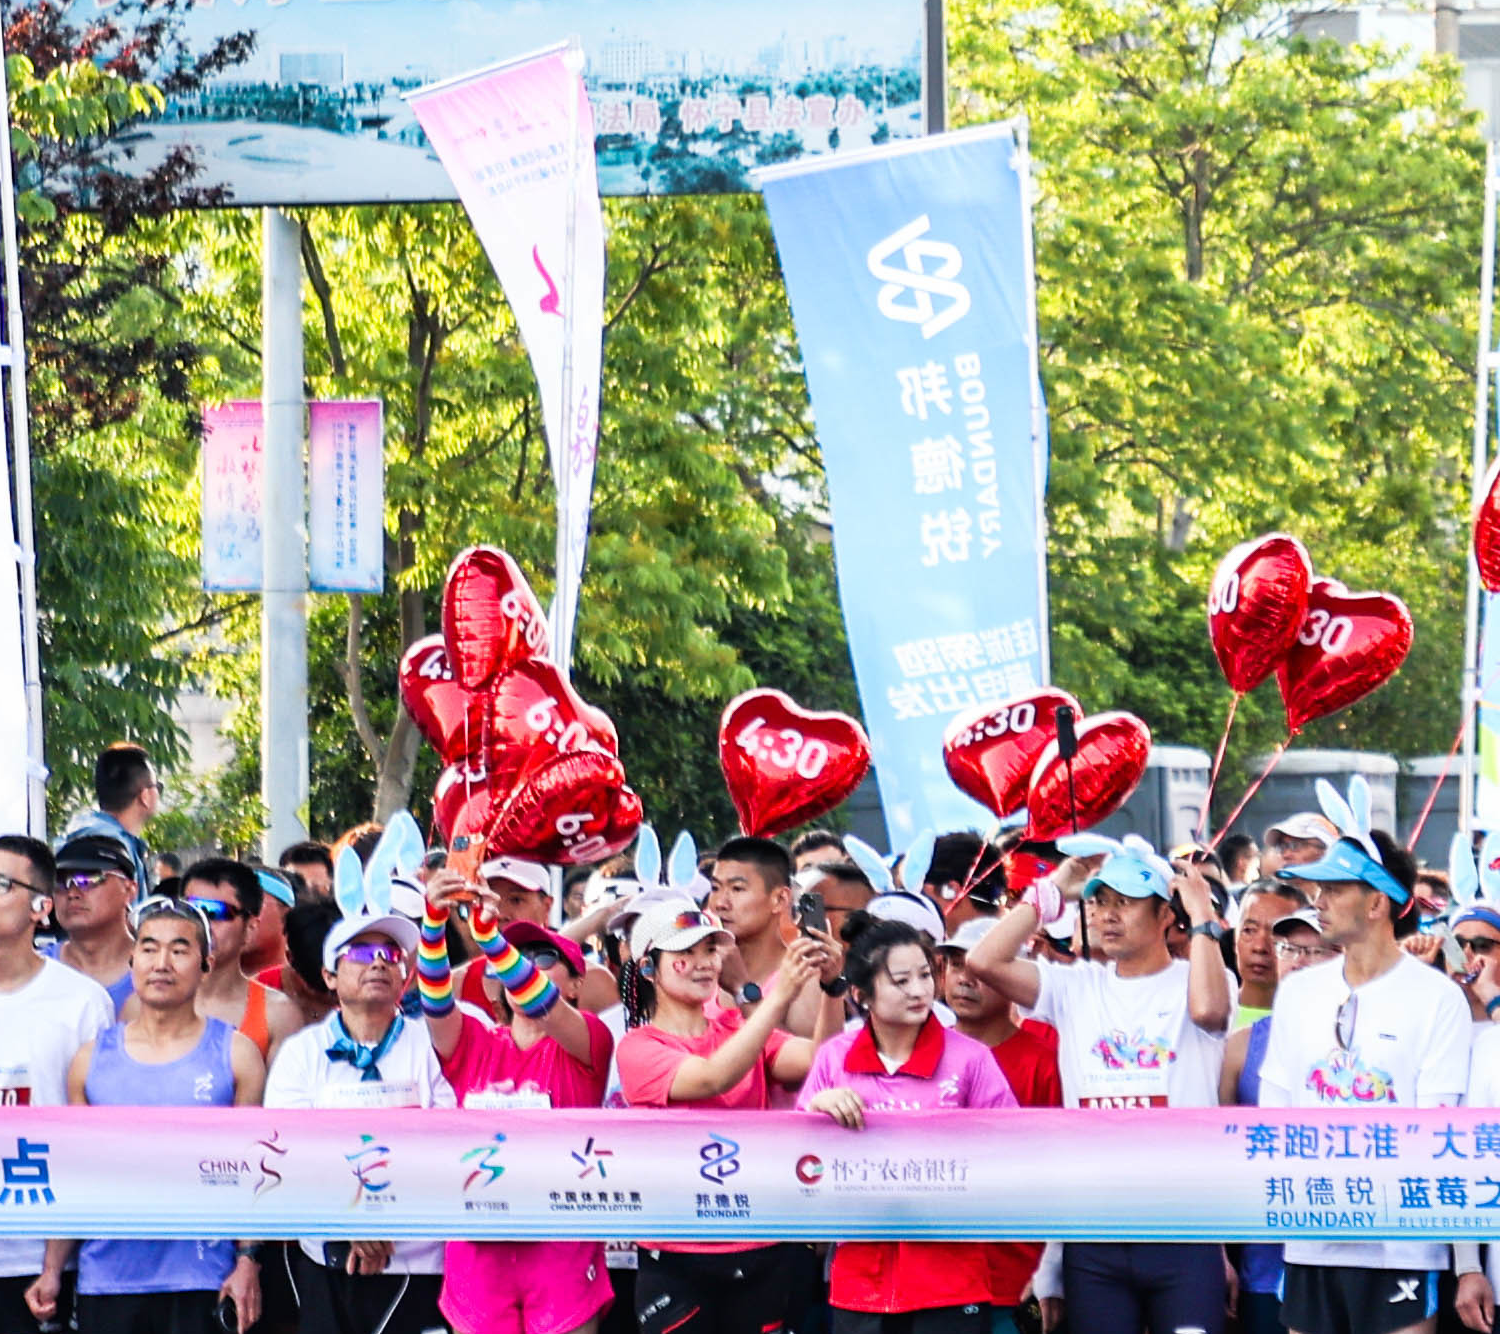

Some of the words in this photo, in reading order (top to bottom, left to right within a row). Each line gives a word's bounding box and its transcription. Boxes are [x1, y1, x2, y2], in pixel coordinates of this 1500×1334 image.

[588, 98, 661, 135] 法局
[1299, 609, 1353, 655] 30
[419, 649, 452, 680] 4:
[735, 716, 828, 780] 4:30
[199, 1159, 251, 1175] CHINA
[833, 1158, 969, 1183] 怀宁农商银行
[549, 1190, 642, 1205] 中国体育彩票
[696, 1193, 749, 1208] 邦德锐
[1265, 1176, 1376, 1206] 邦德锐
[696, 1209, 750, 1219] BOUNDARY
[1266, 1211, 1377, 1228] BOUNDARY
[1398, 1216, 1492, 1228] BLUEBERRY
